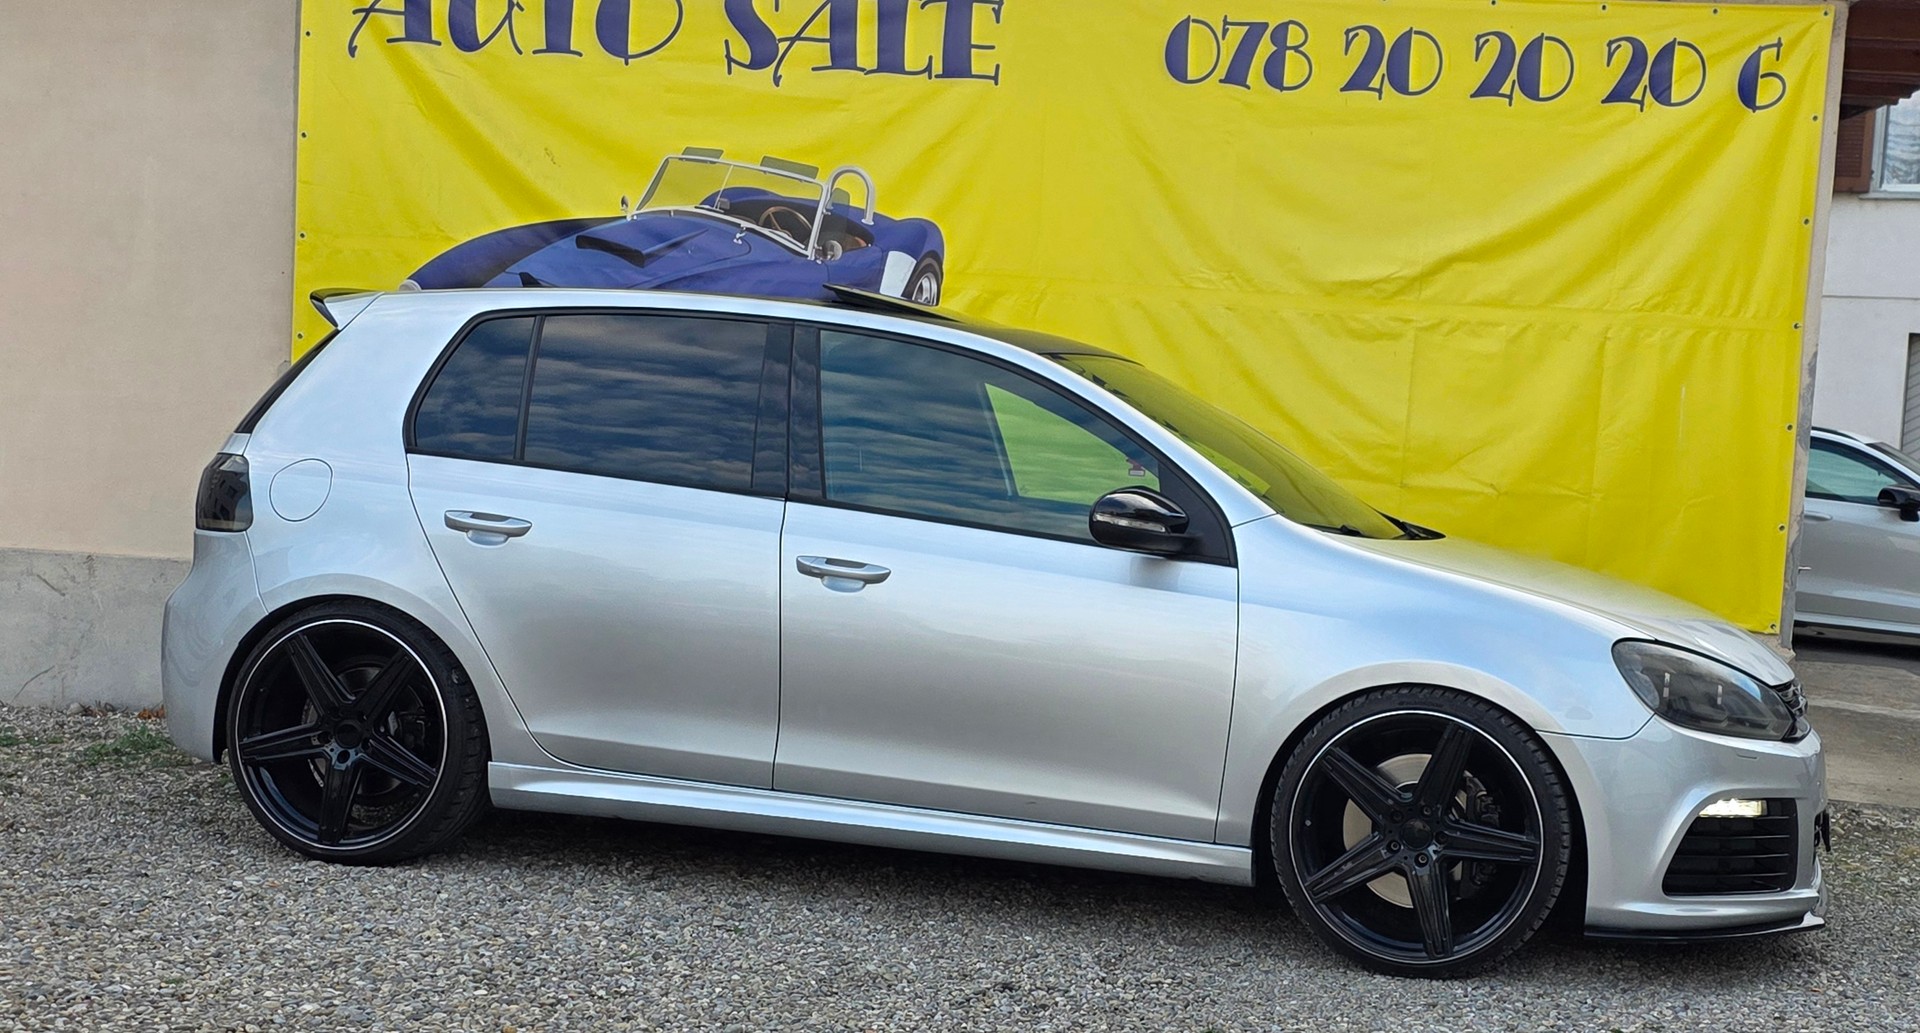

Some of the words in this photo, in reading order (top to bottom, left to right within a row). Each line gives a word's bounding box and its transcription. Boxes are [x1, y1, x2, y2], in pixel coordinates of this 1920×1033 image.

[723, 0, 1004, 87] SALE
[1165, 16, 1311, 92] 078
[1340, 25, 1443, 100] 20
[1470, 31, 1575, 106] 20
[1602, 36, 1706, 112] 20
[1737, 37, 1786, 113] 6
